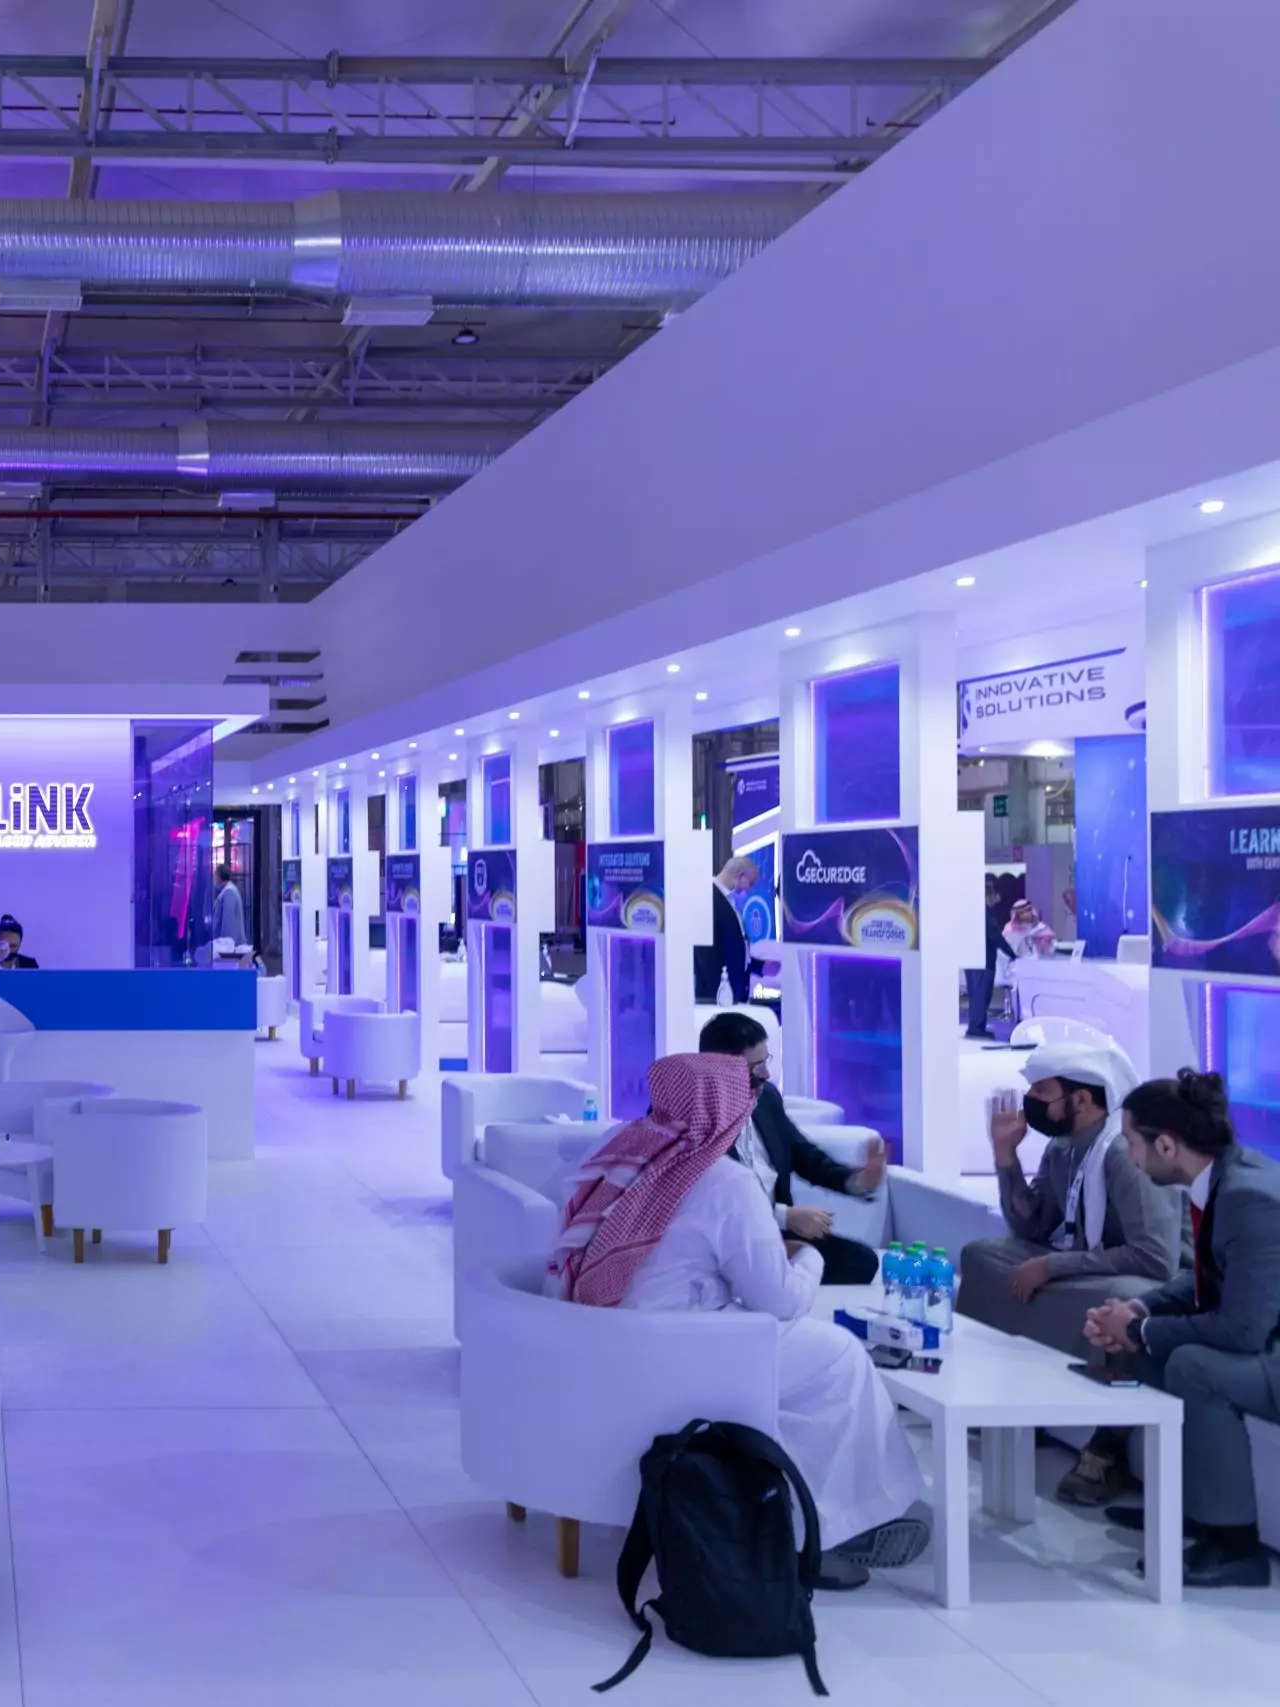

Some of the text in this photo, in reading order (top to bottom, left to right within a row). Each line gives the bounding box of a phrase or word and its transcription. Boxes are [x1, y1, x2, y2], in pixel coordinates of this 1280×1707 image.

[975, 666, 1105, 701] INNOVATIVE
[975, 686, 1106, 719] SOLUTIONS
[1230, 827, 1280, 854] LEARN
